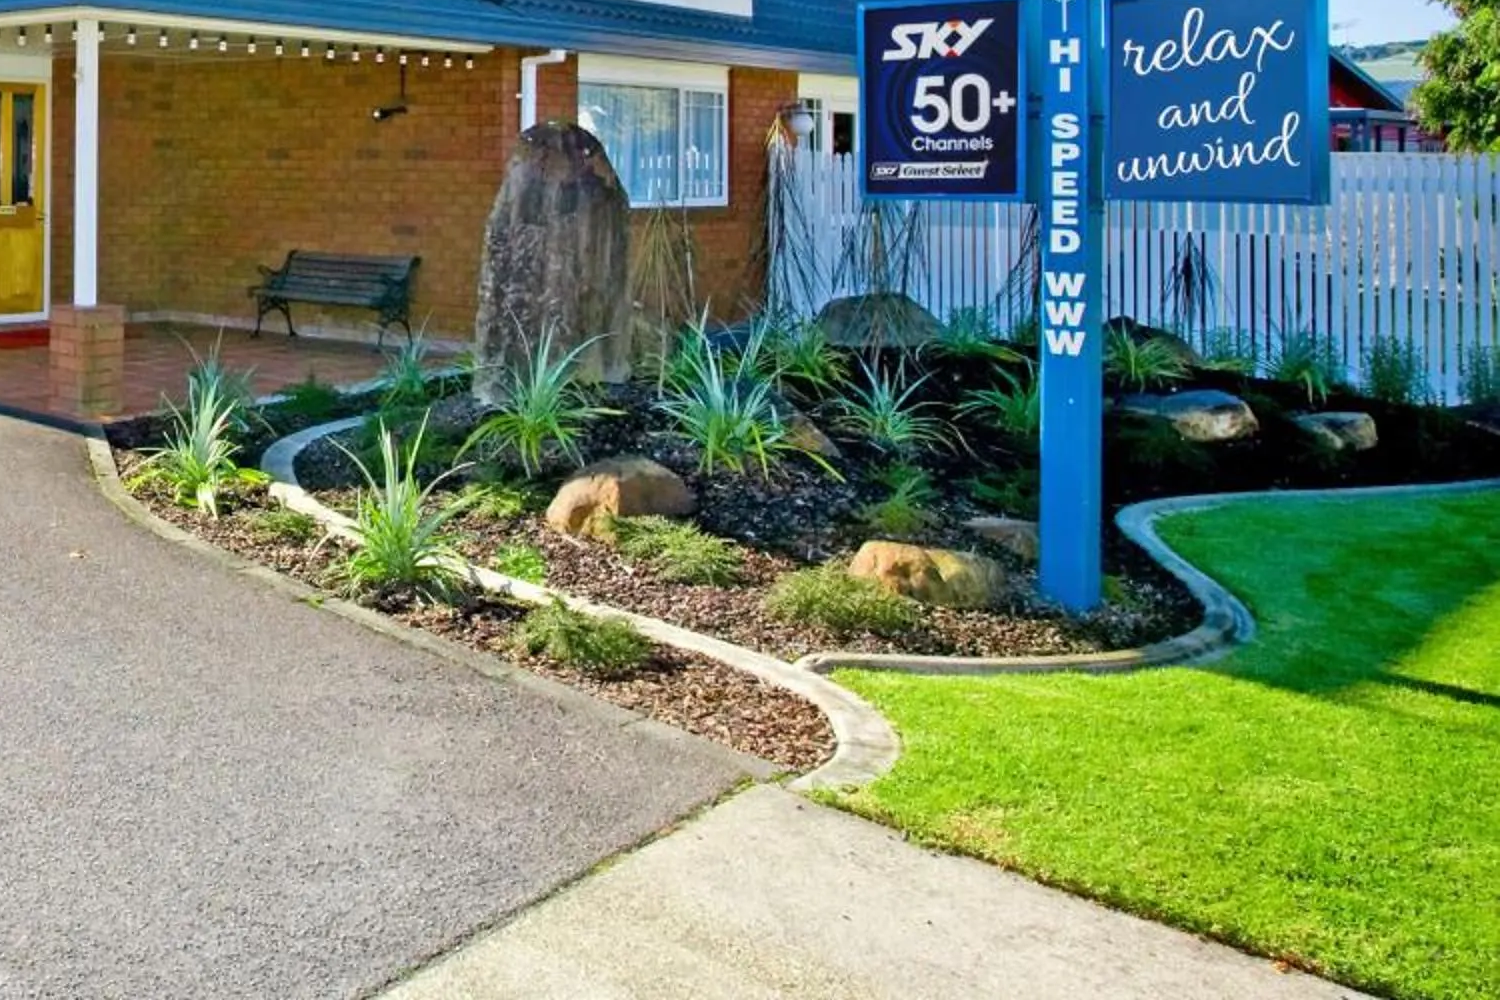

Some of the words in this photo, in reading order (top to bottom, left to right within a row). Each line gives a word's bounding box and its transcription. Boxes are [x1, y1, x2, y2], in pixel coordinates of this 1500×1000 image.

[882, 18, 994, 61] SKY
[1049, 39, 1081, 92] HI
[1122, 7, 1294, 77] relax
[910, 73, 1016, 133] 50+
[1158, 72, 1256, 130] and
[903, 165, 938, 177] Guest
[942, 163, 981, 176] Select
[911, 135, 994, 151] Channels
[1117, 111, 1300, 182] unwind
[1051, 113, 1081, 253] SPEED
[1045, 271, 1085, 356] WWW
